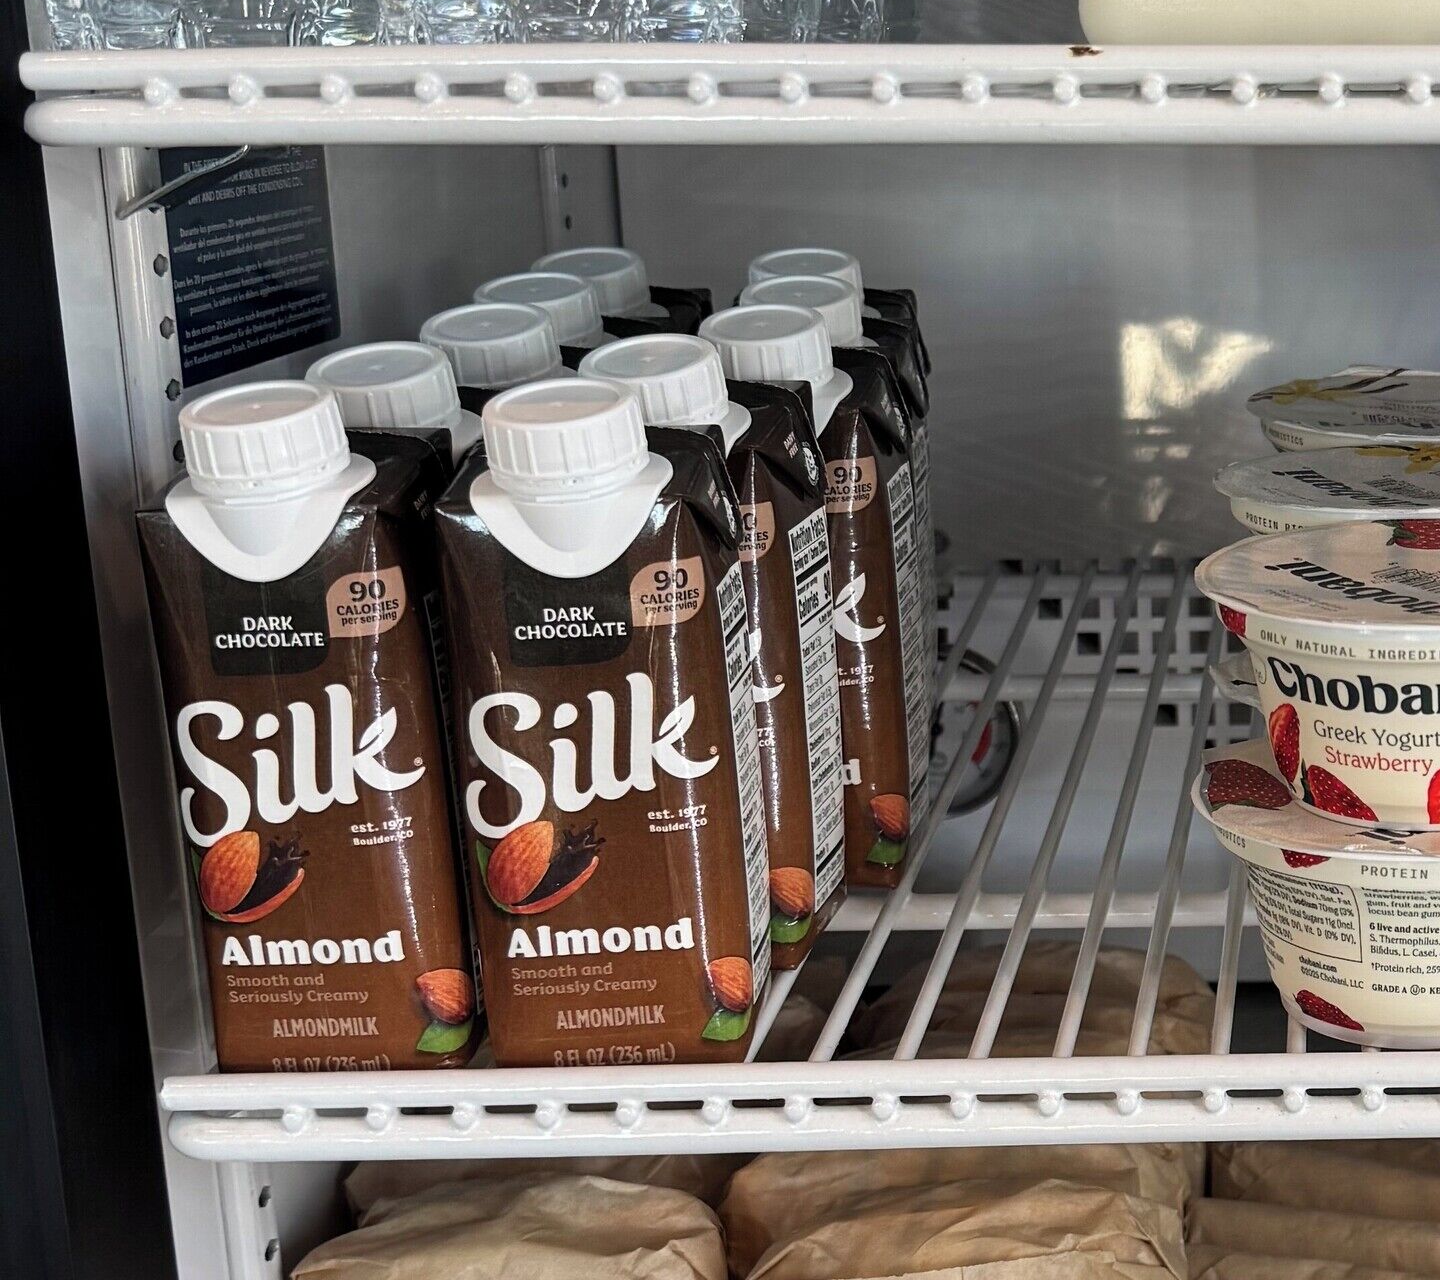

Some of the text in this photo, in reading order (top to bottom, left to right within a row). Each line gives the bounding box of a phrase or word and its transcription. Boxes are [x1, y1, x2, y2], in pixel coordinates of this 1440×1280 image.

[834, 466, 862, 485] 90
[653, 567, 688, 591] 90
[349, 579, 386, 602] 90
[640, 588, 700, 606] CALORIES
[336, 598, 399, 617] CALORIES
[543, 606, 595, 622] DARK
[242, 615, 294, 633] DARK
[515, 621, 627, 641] CHOCOLATE
[215, 631, 325, 650] CHOCOLATE
[1260, 629, 1288, 647] ONLY
[1296, 639, 1356, 658] NATURAL
[1313, 720, 1368, 746] Greek
[466, 672, 719, 838] Silk
[1325, 745, 1433, 777] Strawberry
[177, 683, 426, 847] Silk
[1361, 865, 1428, 879] PROTEIN
[508, 918, 694, 958] Almond
[1413, 924, 1439, 934] active
[222, 930, 406, 967] Almond
[227, 973, 325, 988] Smooth and
[512, 962, 613, 980] Smooth and
[229, 989, 369, 1005] Seriously Creamy
[513, 978, 657, 997] Seriously Creamy
[1372, 983, 1400, 994] GRADE
[556, 1005, 665, 1030] ALMONDMILK
[272, 1016, 380, 1039] ALMONDMILK
[553, 1050, 563, 1066] 8
[567, 1050, 581, 1066] FL
[587, 1047, 603, 1066] OZ
[609, 1045, 642, 1065] (236
